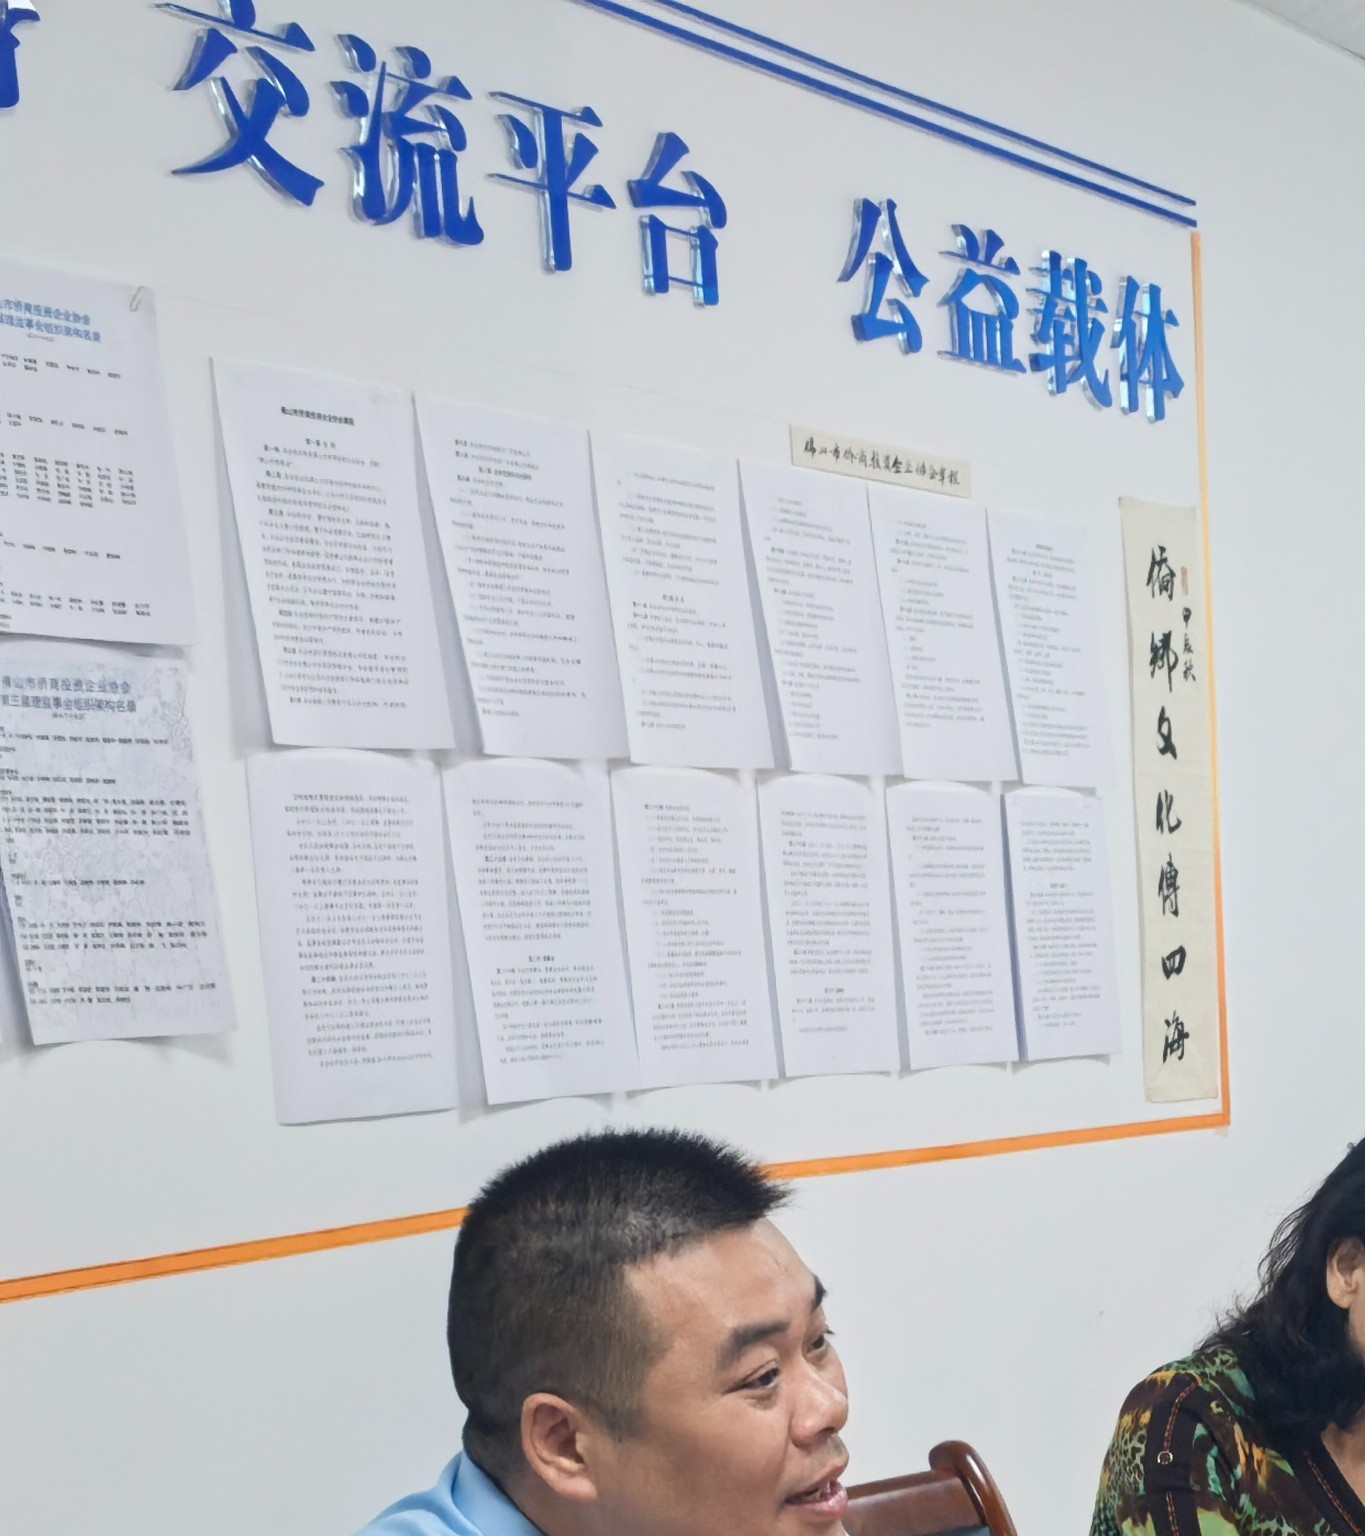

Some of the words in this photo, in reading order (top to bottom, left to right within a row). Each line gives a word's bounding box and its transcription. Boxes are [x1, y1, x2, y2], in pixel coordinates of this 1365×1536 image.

[155, 0, 728, 307] 交流平台
[838, 197, 1186, 423] 公益载体
